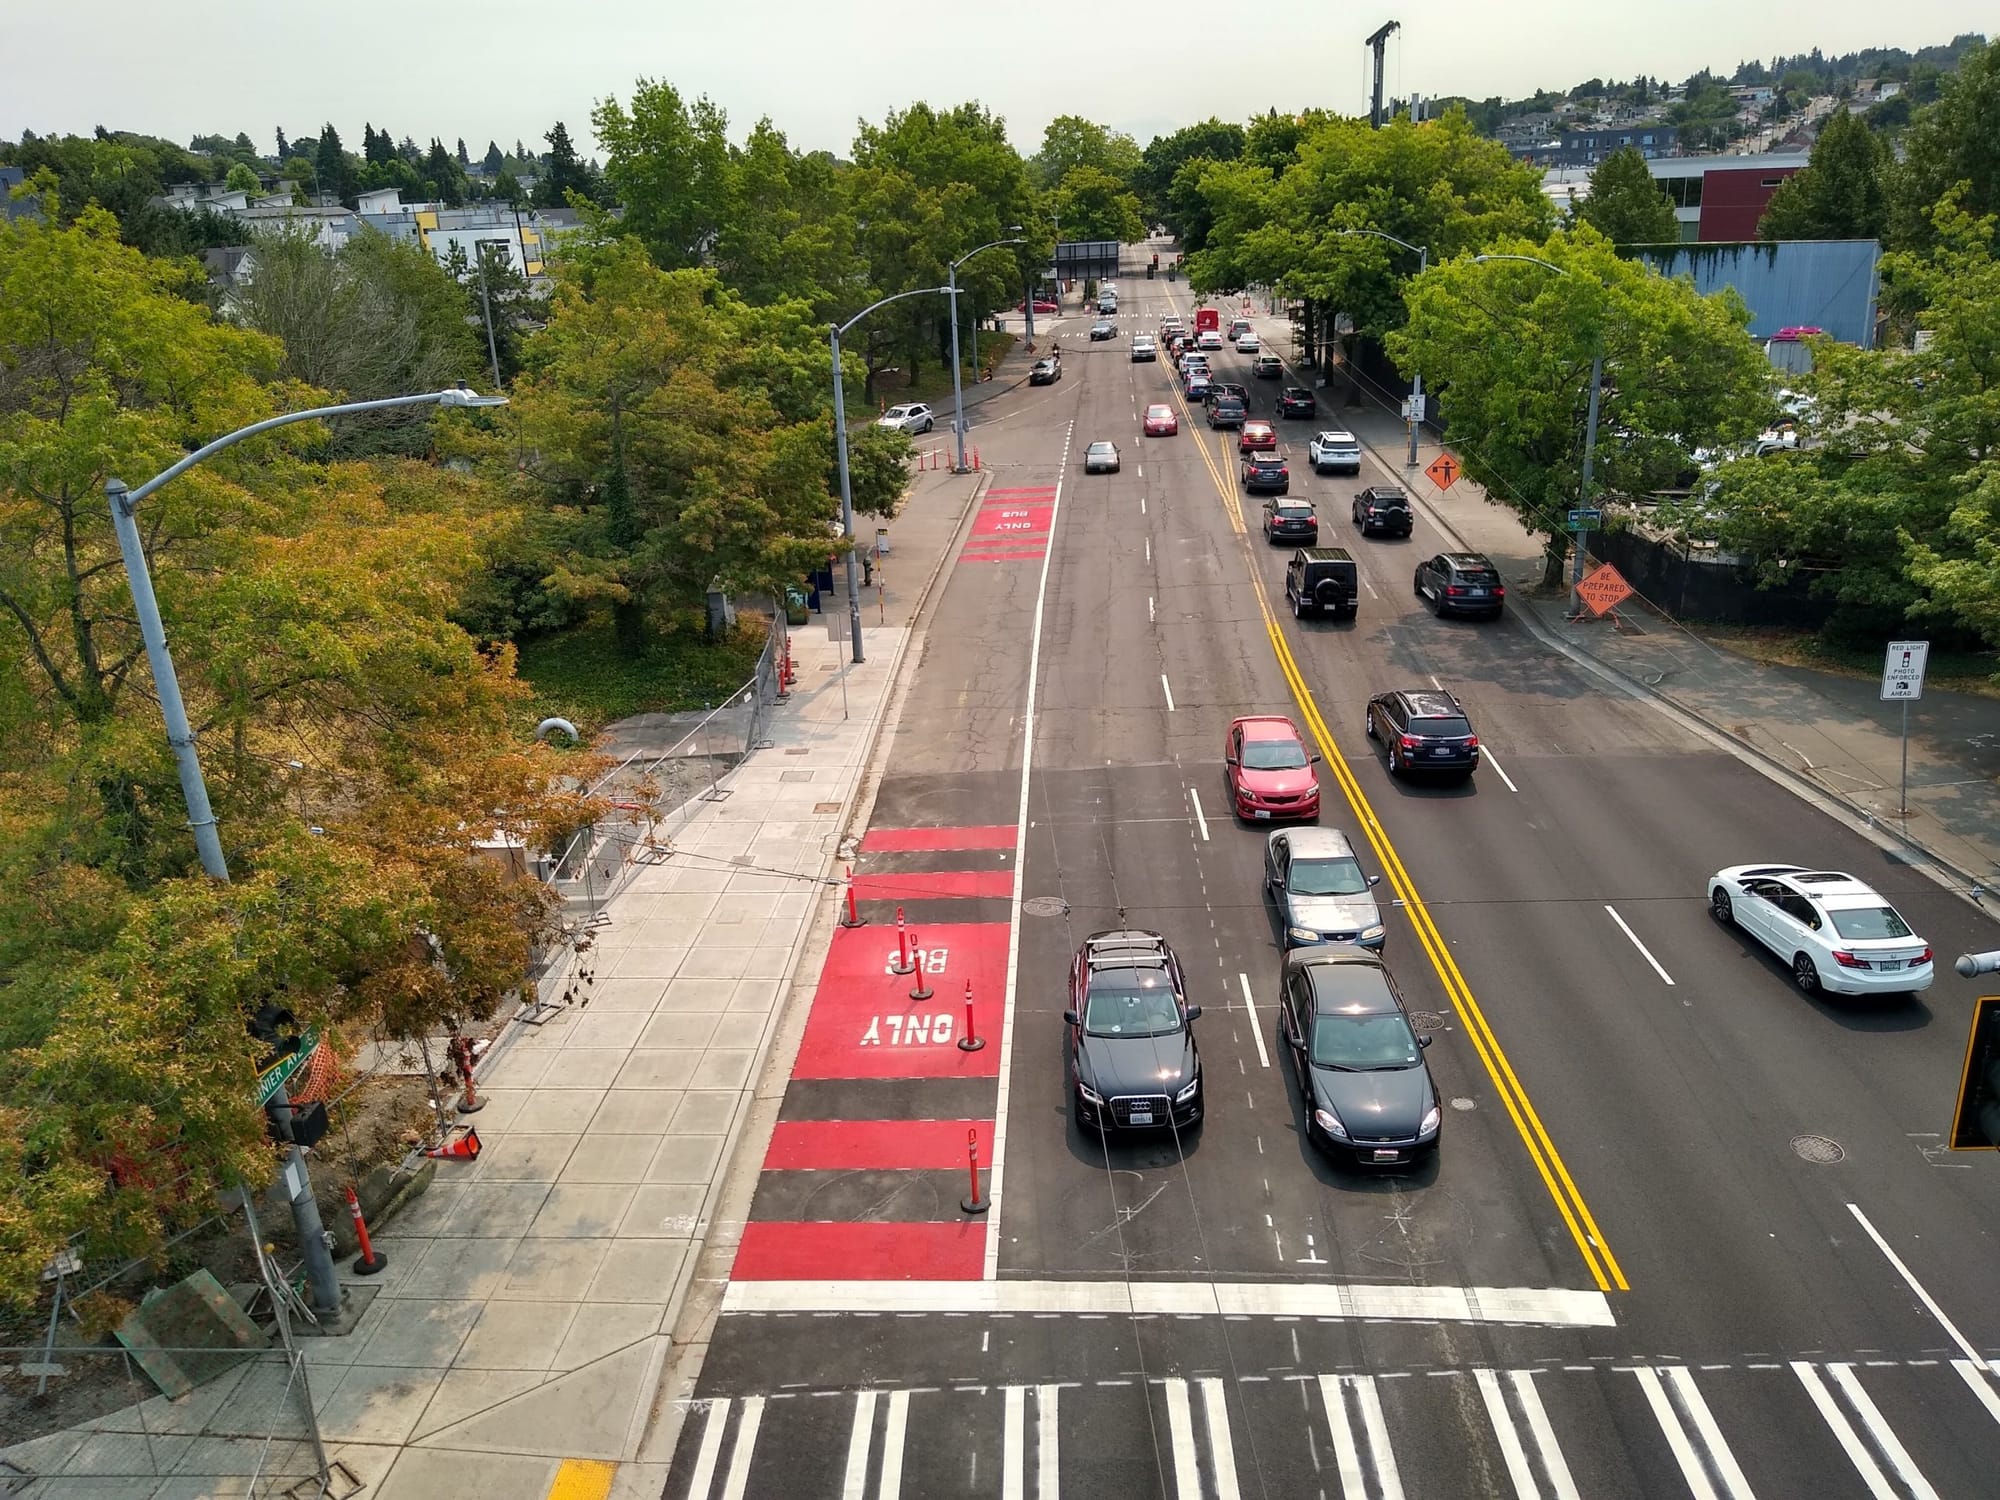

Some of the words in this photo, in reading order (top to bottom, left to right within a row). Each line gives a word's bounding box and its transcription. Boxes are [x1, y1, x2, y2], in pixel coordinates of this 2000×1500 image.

[1600, 572, 1611, 581] BE
[1582, 582, 1625, 592] PREPARED
[1586, 592, 1596, 601] TO
[1599, 593, 1619, 603] STOP
[885, 949, 948, 975] BUS
[860, 1014, 953, 1046] ONLY
